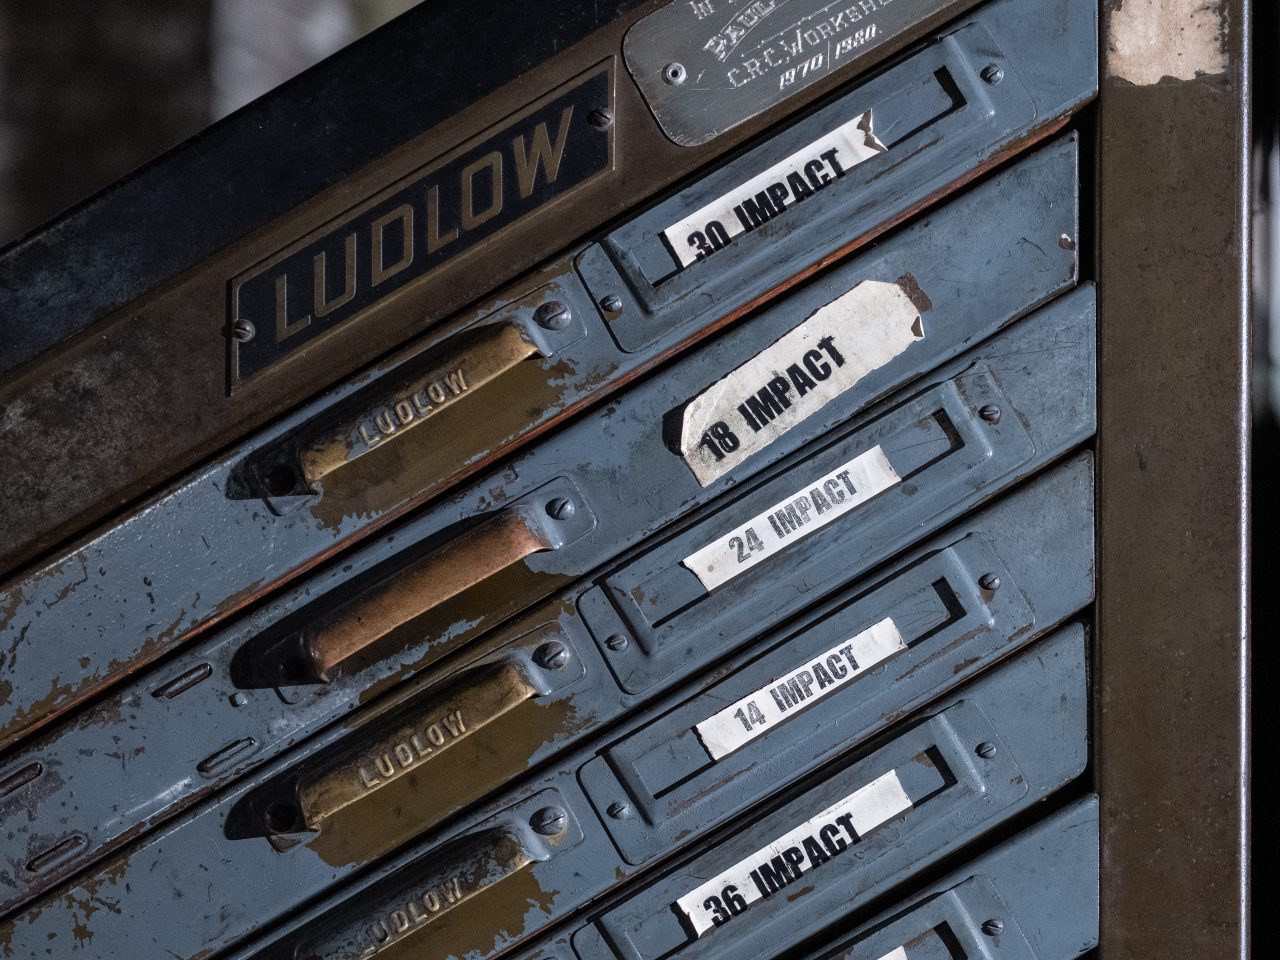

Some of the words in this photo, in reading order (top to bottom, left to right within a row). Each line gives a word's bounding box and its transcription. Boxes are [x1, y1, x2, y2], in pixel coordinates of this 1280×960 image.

[275, 104, 575, 343] LUDLOW
[687, 230, 730, 262] 30
[733, 145, 848, 234] IMPACT
[357, 369, 469, 448] LUDLOW
[699, 419, 741, 463] 18
[736, 335, 847, 434] IMPACT
[728, 527, 764, 564] 24
[767, 469, 858, 539] IMPACT
[733, 701, 767, 732] 14
[769, 643, 861, 714] IMPACT
[357, 709, 467, 789] LUDLOW
[356, 876, 464, 954] LUDLOW
[702, 884, 749, 928] 36
[750, 811, 862, 900] IMPACT
